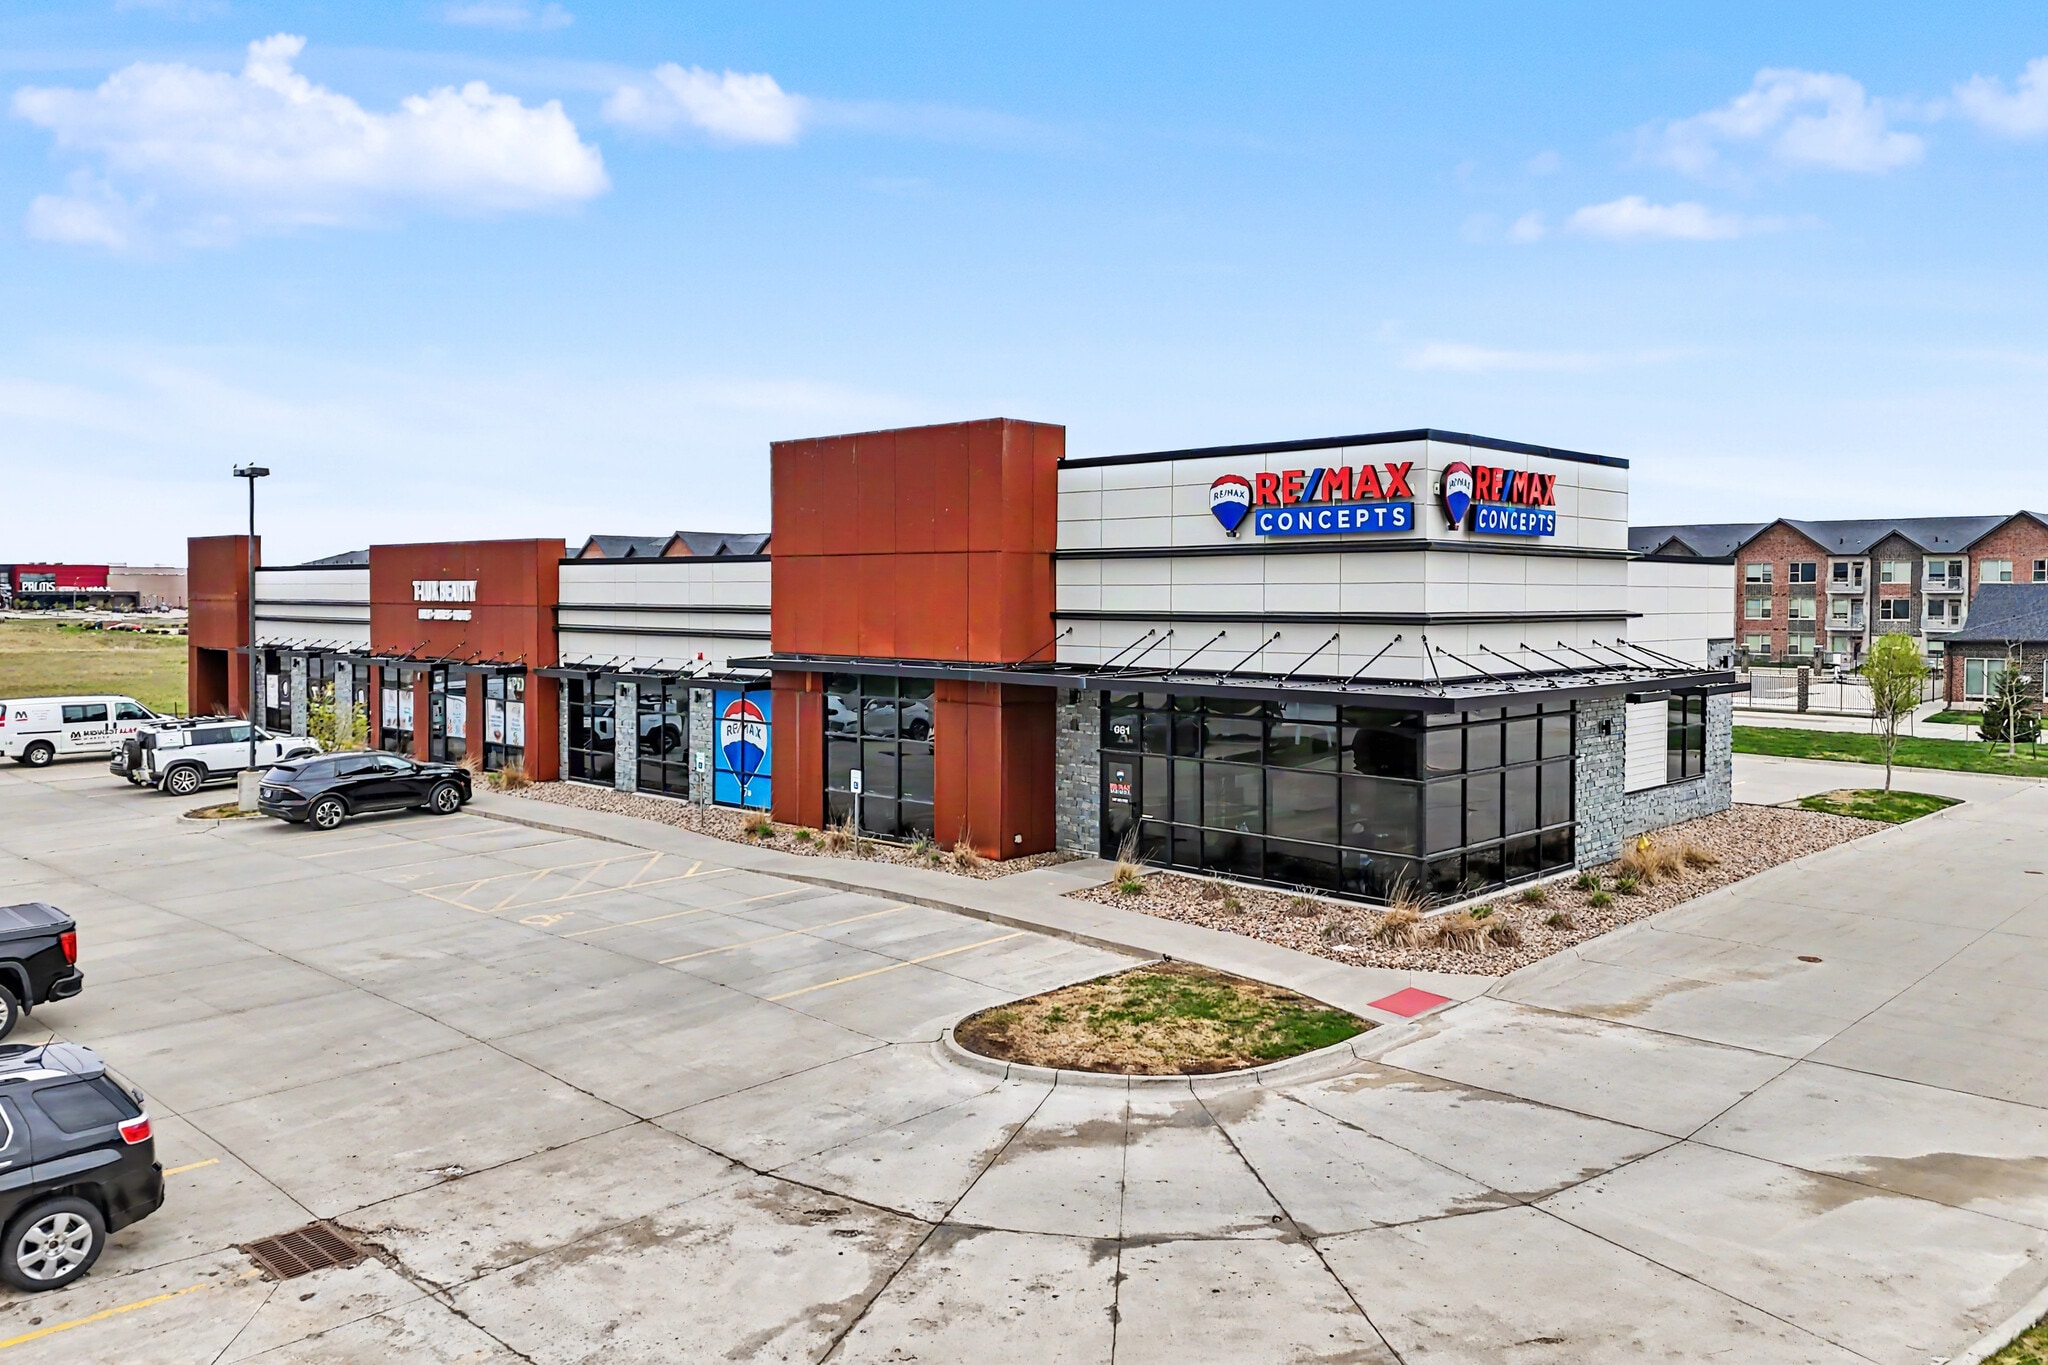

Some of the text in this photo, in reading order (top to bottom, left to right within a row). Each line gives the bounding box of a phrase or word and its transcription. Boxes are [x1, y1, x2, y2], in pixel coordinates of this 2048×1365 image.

[1213, 489, 1246, 501] RE/MAX
[1256, 462, 1414, 505] RE/MAX
[1475, 465, 1556, 506] RE/MAX
[1259, 507, 1406, 531] CONCEPTS
[1478, 509, 1554, 532] CONCEPTS
[22, 581, 55, 592] PALMS
[727, 723, 762, 740] RE/MAX
